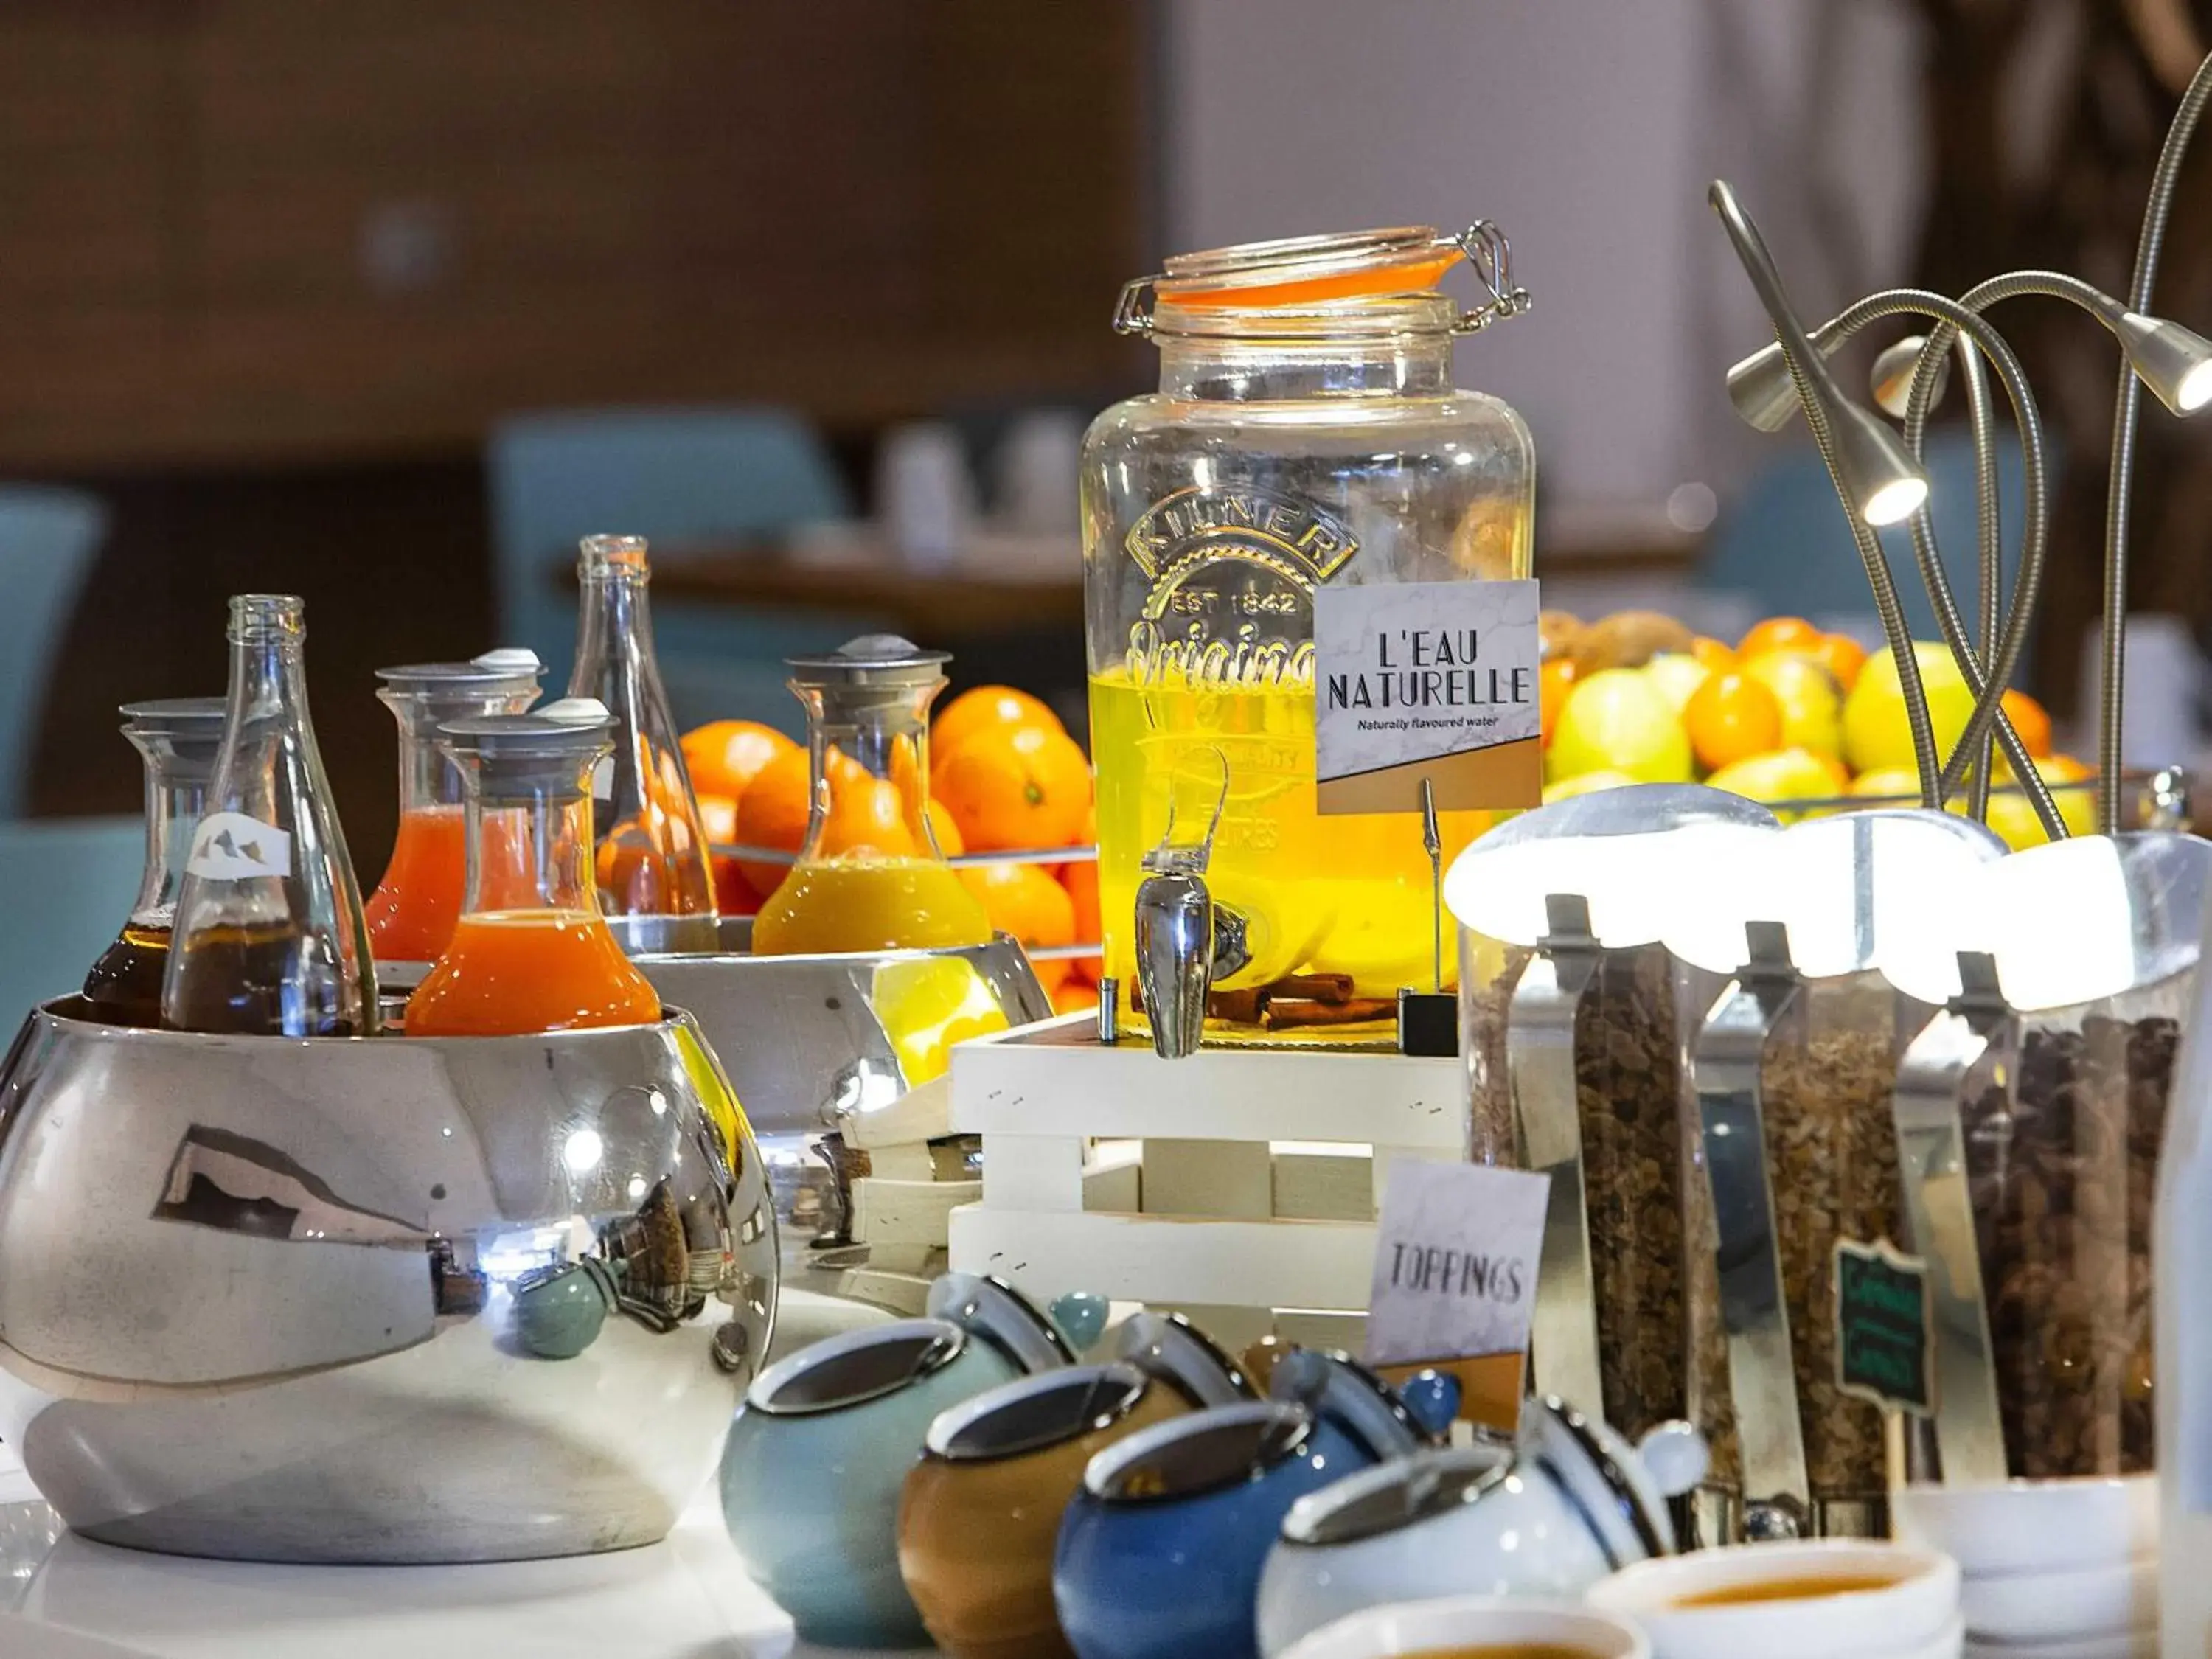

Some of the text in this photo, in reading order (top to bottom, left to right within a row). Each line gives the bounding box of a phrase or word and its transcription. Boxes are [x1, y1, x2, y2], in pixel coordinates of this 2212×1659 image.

[1133, 493, 1338, 566] KILNER
[1171, 591, 1297, 615] EST 1842
[1126, 621, 1317, 704] Origina
[1380, 630, 1478, 667] L'EAU
[1329, 668, 1530, 709] NATURELLE
[1358, 717, 1498, 731] Naturally flavoured water
[1391, 1242, 1523, 1304] TOPPINGS
